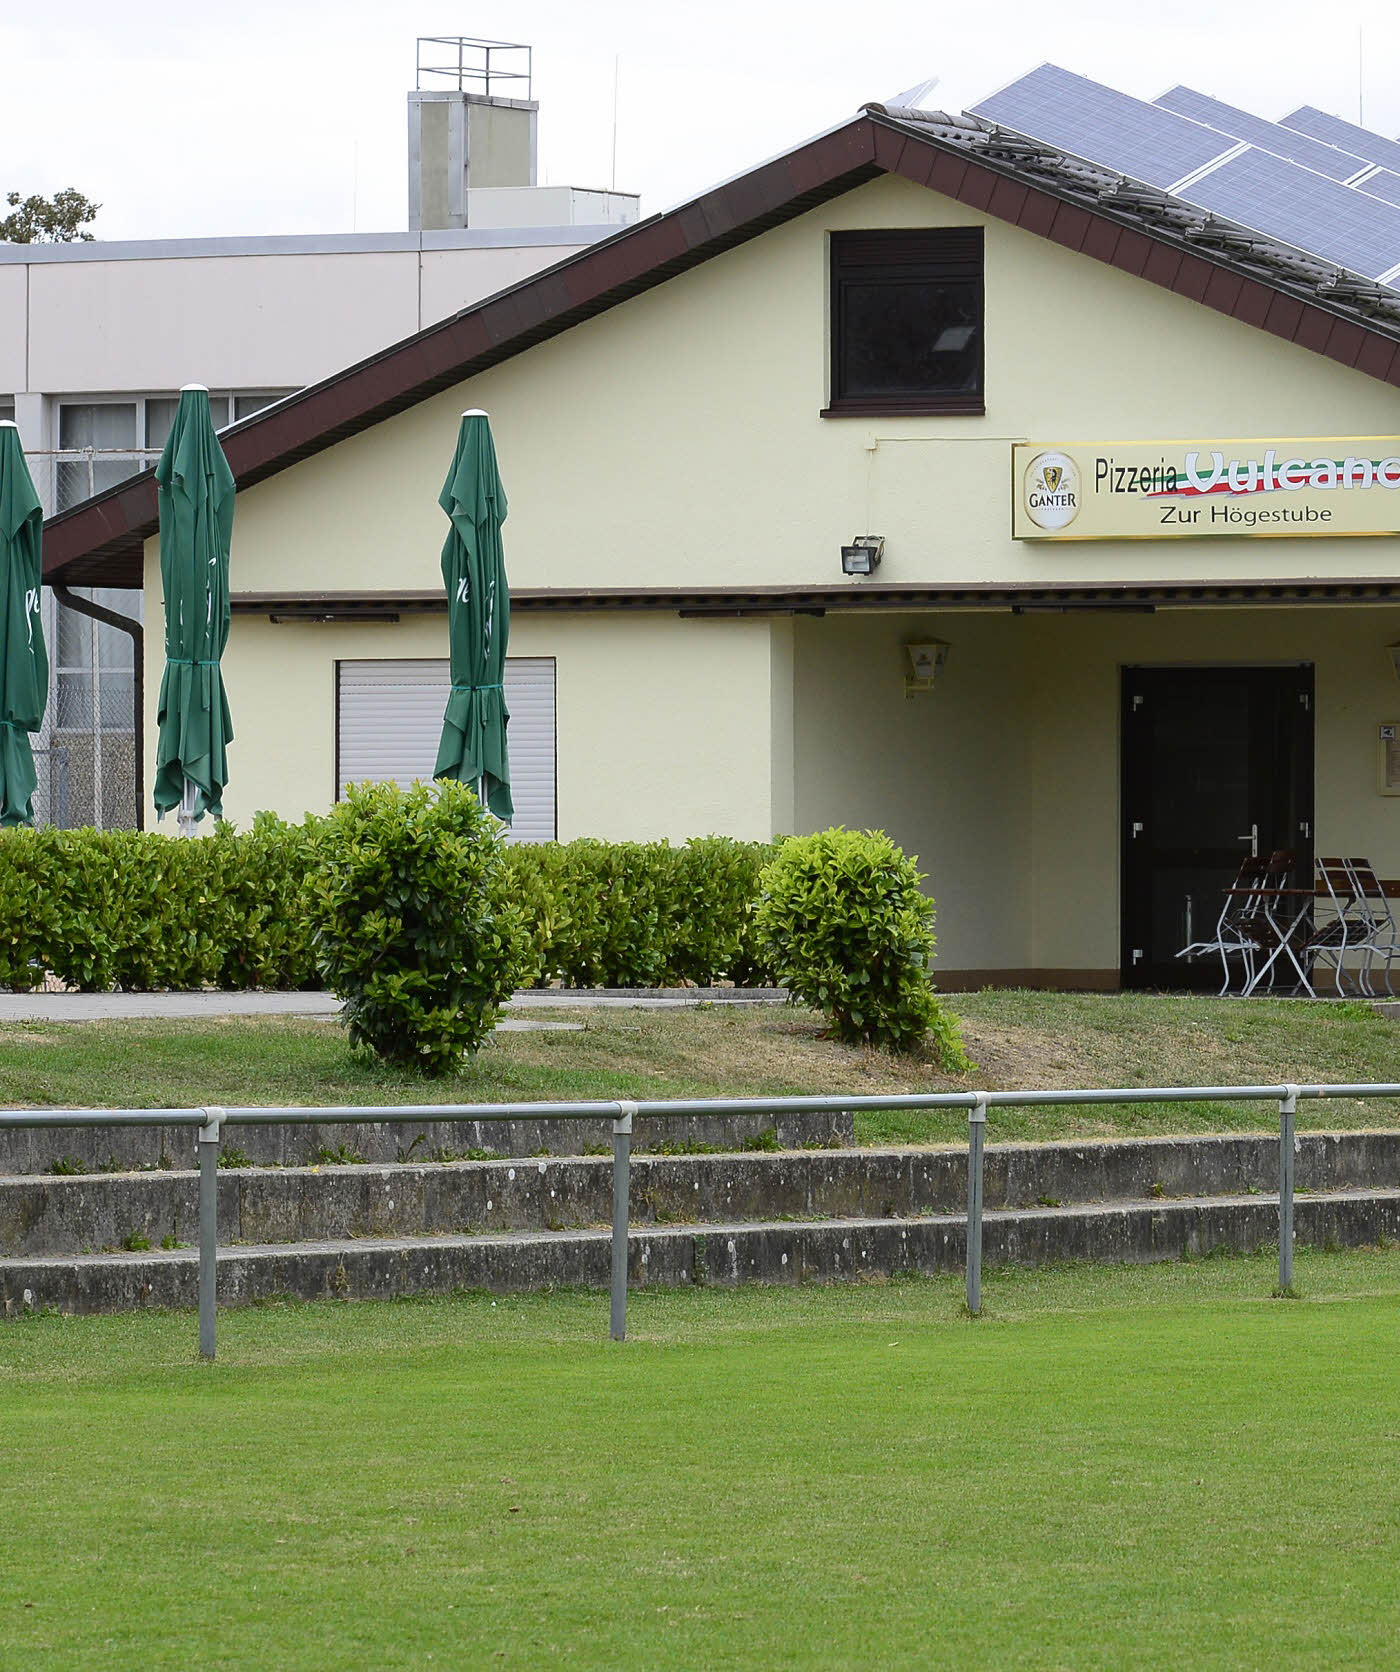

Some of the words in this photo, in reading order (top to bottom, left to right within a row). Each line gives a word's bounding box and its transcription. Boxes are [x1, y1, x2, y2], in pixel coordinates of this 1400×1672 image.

[1095, 457, 1178, 494] Pizzeria
[1029, 493, 1077, 508] GANTER
[1160, 506, 1202, 524] Zur
[1211, 505, 1333, 527] Högestube
